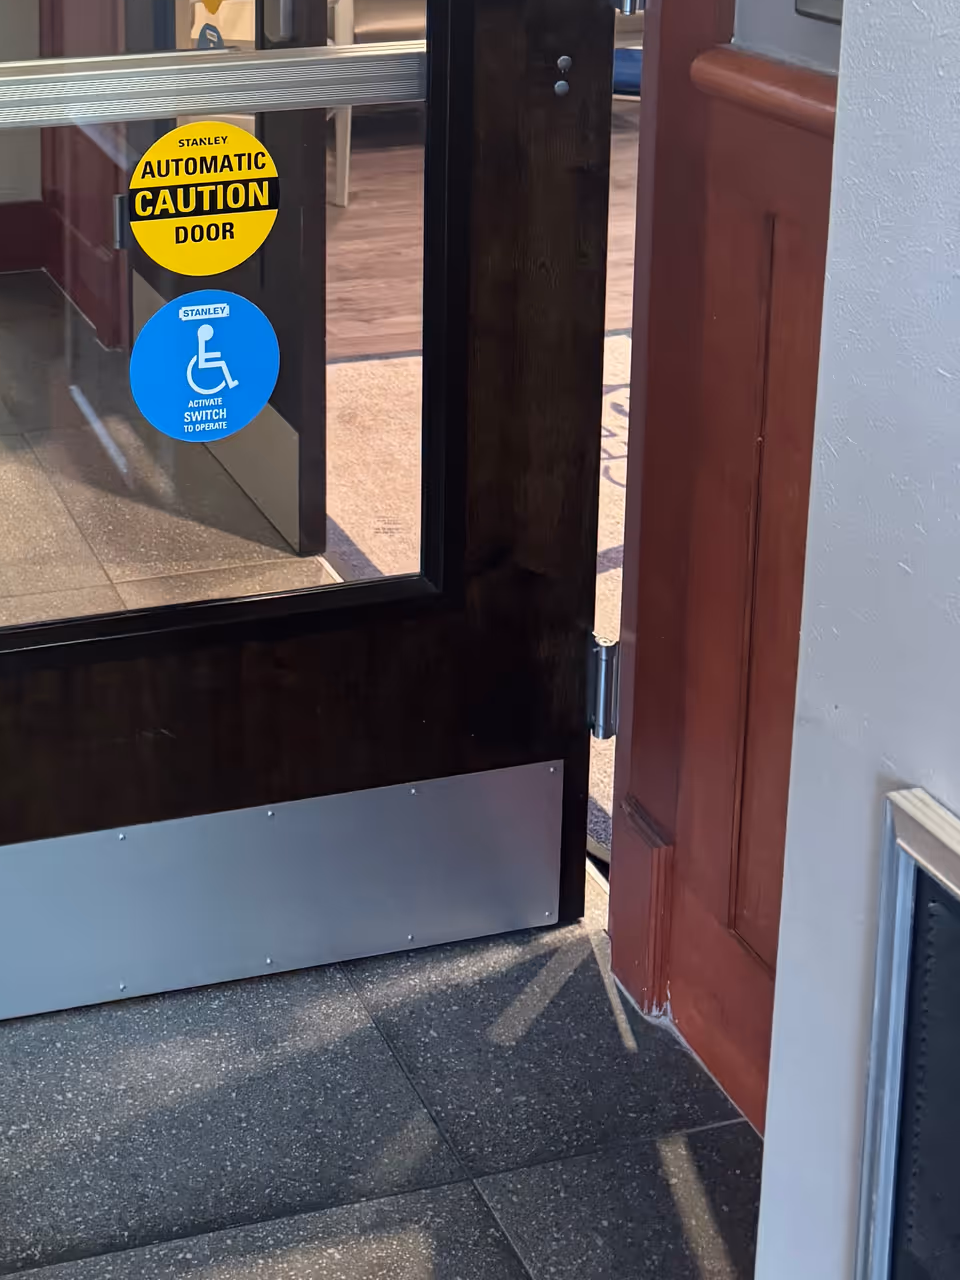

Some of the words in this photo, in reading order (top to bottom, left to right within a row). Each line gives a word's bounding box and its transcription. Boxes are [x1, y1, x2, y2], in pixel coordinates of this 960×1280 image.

[178, 136, 228, 148] STANLEY
[141, 152, 266, 179] AUTOMATIC
[134, 180, 269, 217] CAUTION
[175, 222, 234, 244] DOOR
[183, 306, 226, 318] STANLEY
[188, 398, 222, 408] ACTIVATE
[184, 408, 227, 422] SWITCH
[184, 424, 193, 433] TO
[195, 422, 228, 432] OPERATE
